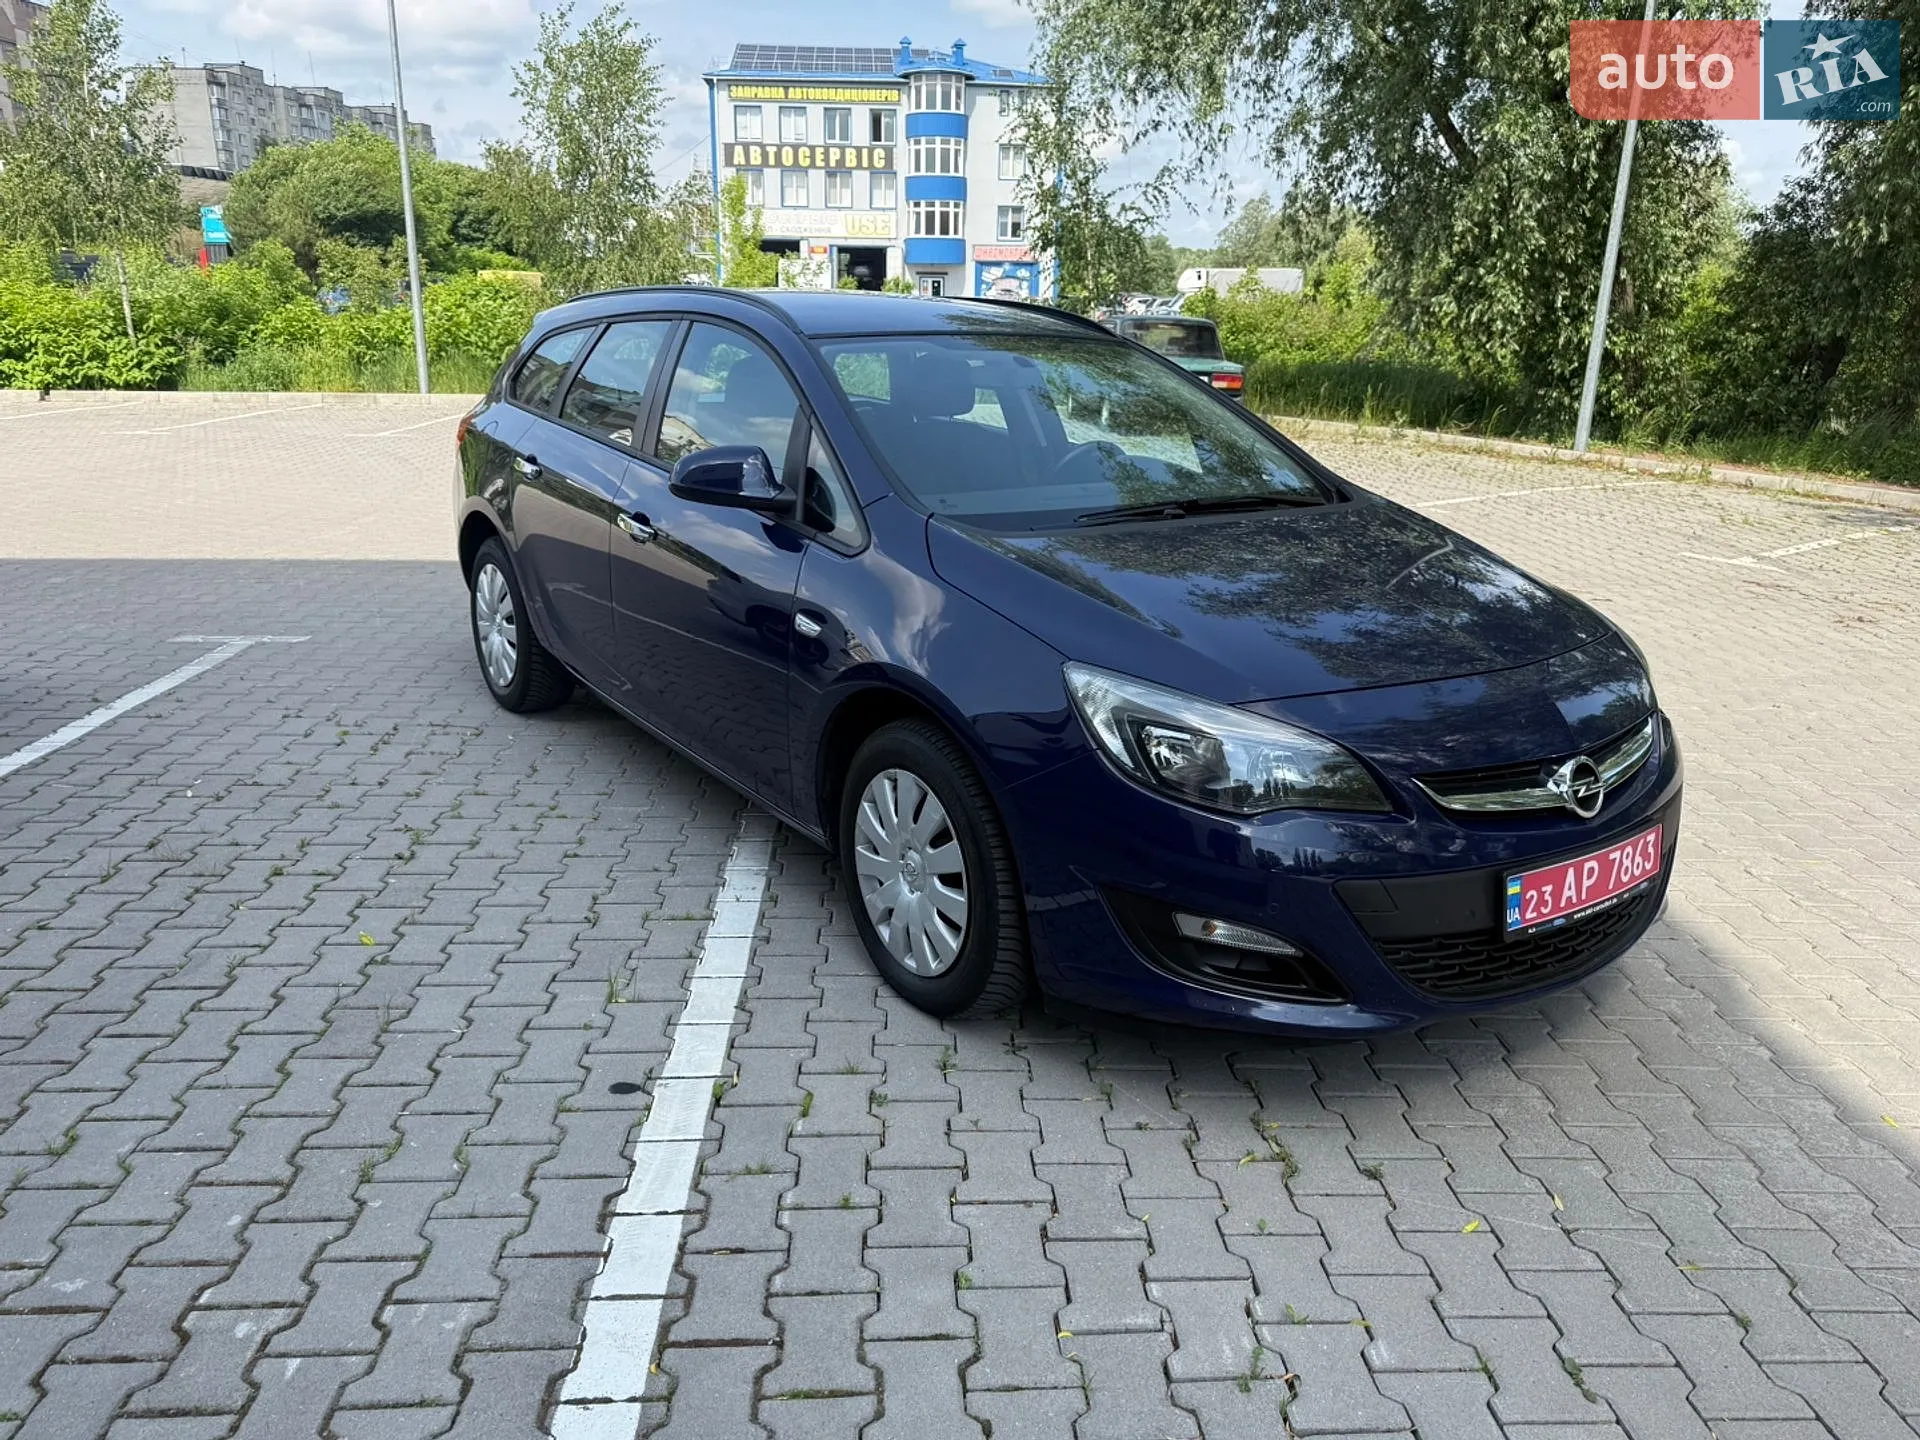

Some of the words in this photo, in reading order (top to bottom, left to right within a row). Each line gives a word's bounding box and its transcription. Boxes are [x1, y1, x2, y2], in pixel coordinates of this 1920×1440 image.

[730, 85, 785, 99] ЗАПРАВКА
[733, 145, 886, 168] АВТОСЕРВІС
[844, 213, 891, 235] USE
[1525, 884, 1553, 920] 23
[1559, 860, 1599, 908] AP
[1608, 832, 1656, 890] 7863
[1506, 908, 1521, 923] UA
